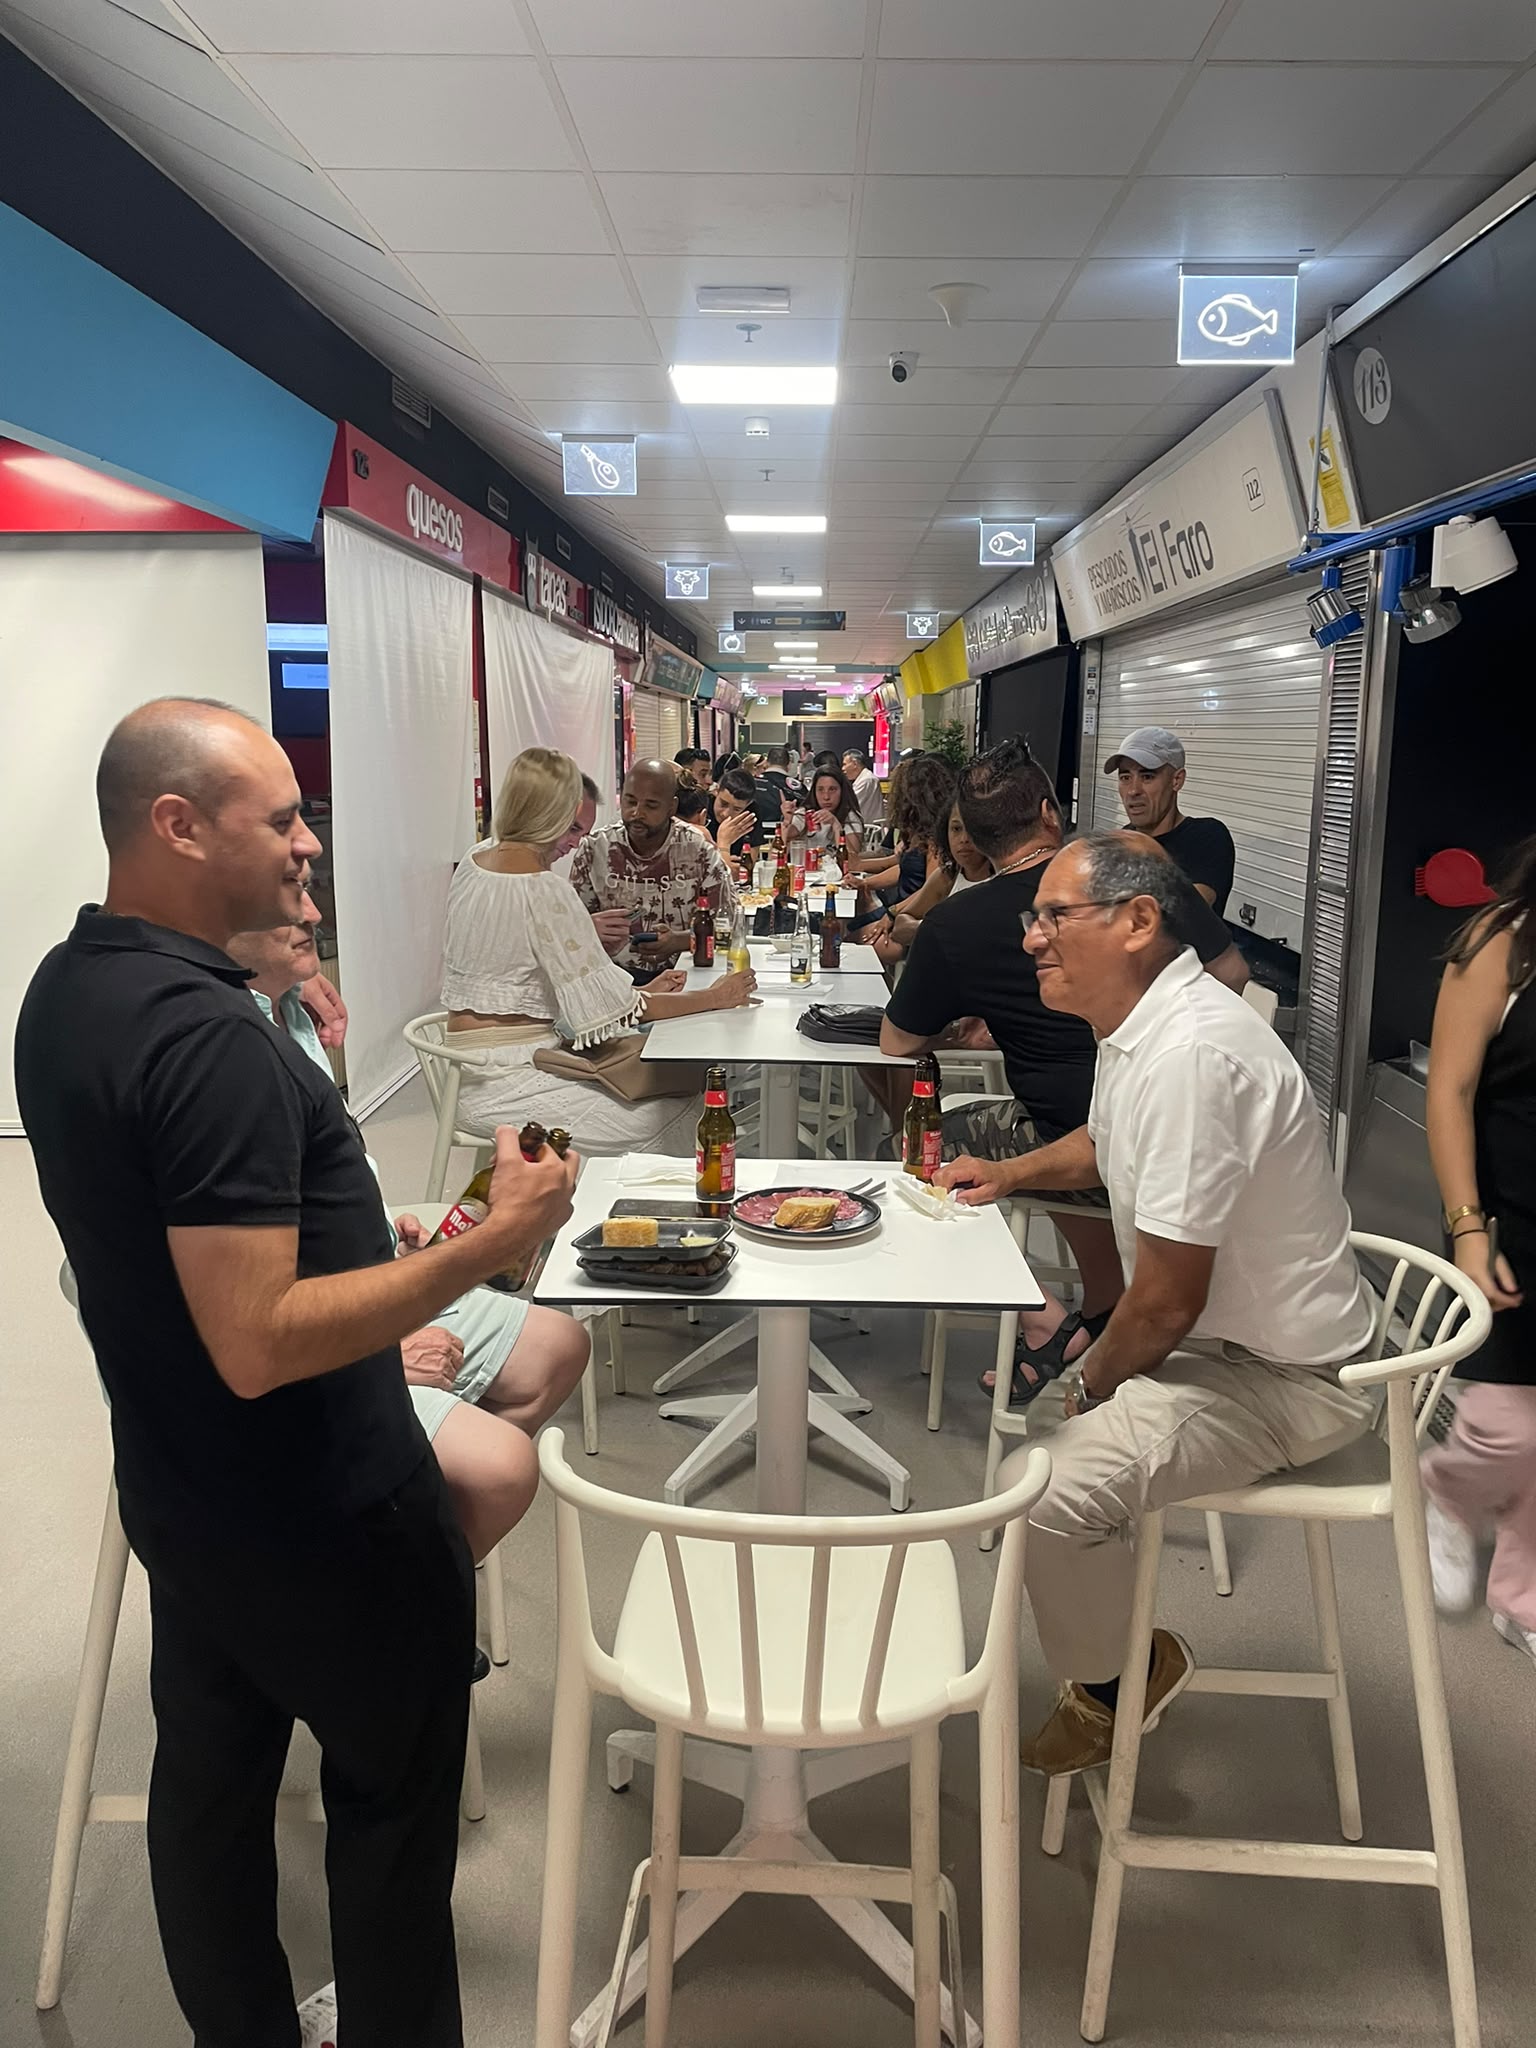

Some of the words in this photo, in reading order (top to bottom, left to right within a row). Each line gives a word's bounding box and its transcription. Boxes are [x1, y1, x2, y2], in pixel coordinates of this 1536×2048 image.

[1360, 357, 1388, 414] 113
[1246, 479, 1262, 502] 112
[406, 483, 463, 552] quesos
[1087, 549, 1128, 590] PESCADOS
[1139, 529, 1168, 594] El
[1159, 519, 1215, 586] Faro
[540, 555, 567, 623] tapas
[1093, 593, 1103, 617] Y
[1099, 576, 1142, 616] MARISCOS
[759, 617, 772, 625] WC
[604, 872, 688, 892] GUESS
